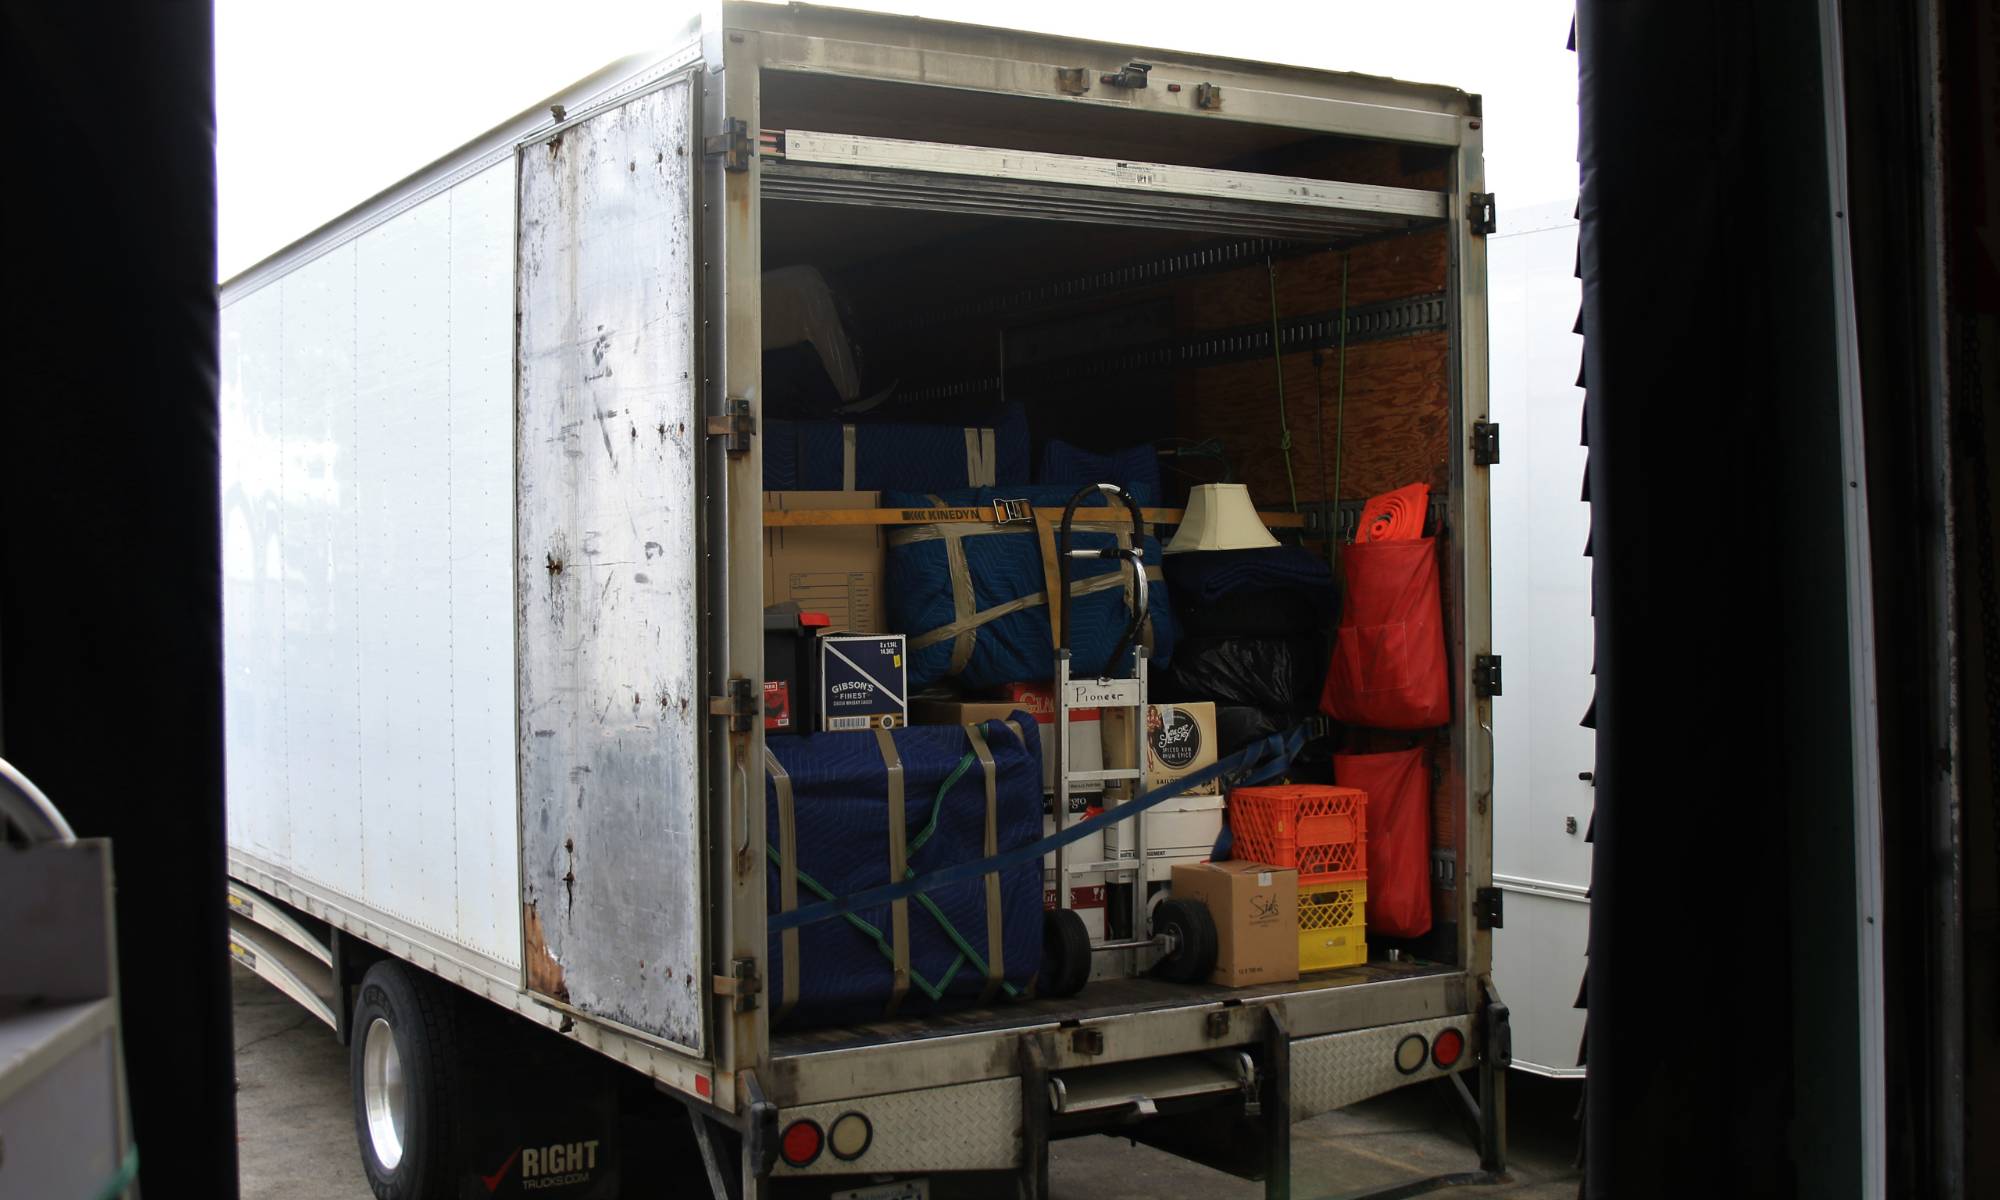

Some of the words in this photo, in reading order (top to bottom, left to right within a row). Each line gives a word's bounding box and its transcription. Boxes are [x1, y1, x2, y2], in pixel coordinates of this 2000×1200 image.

[839, 692, 867, 700] FINEST
[1075, 686, 1124, 702] Pioneer
[522, 1139, 599, 1178] RIGHT
[522, 1171, 590, 1191] TRUCKS.COM
